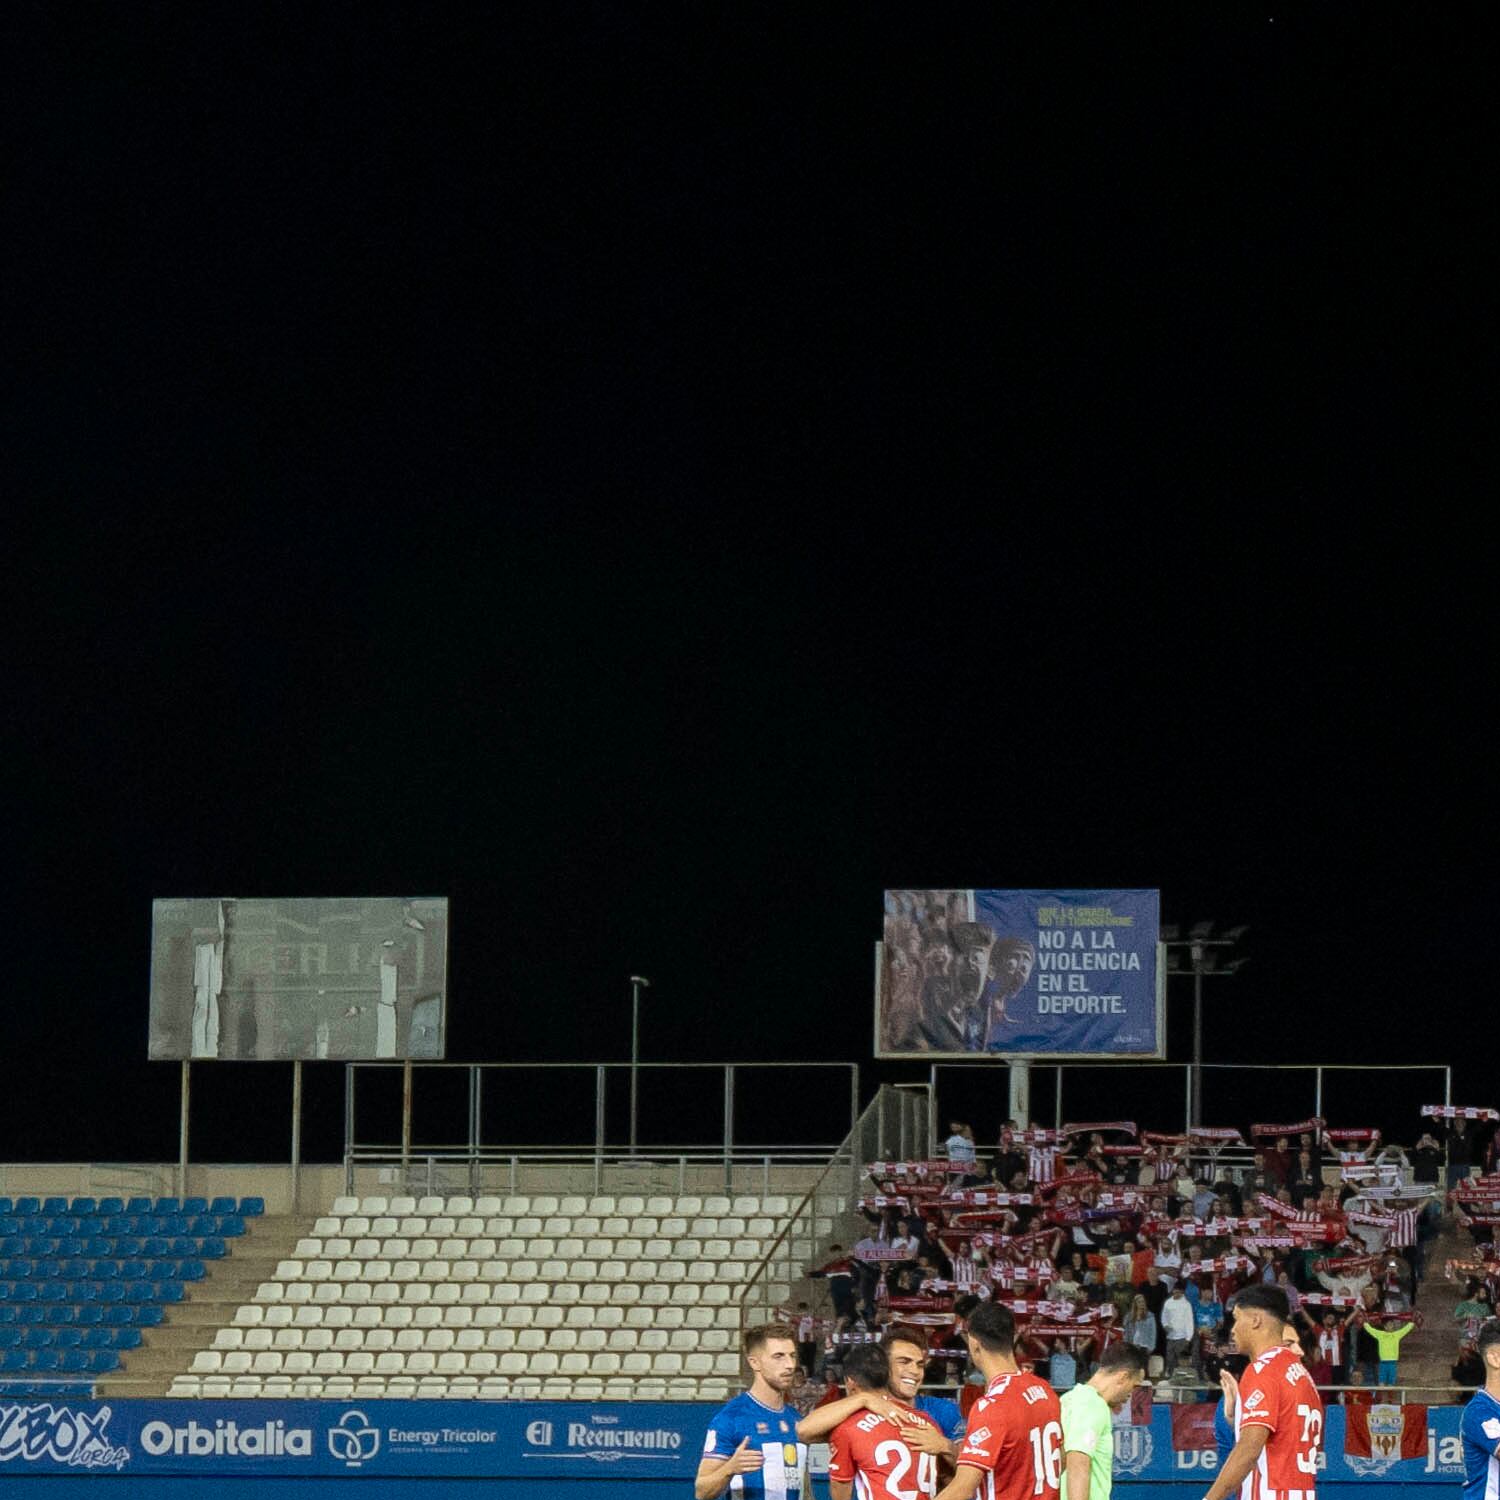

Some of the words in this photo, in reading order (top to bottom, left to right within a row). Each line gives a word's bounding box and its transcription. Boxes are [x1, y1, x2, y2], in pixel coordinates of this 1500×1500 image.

[1038, 930, 1066, 949] NO
[1071, 930, 1085, 949] A
[1091, 930, 1116, 949] LA
[1038, 952, 1141, 971] VIOLENCIA
[1037, 974, 1063, 993] EN
[1068, 974, 1090, 993] EL
[1037, 995, 1128, 1014] DEPORTE.
[140, 1419, 312, 1456] Orbitalia
[388, 1428, 439, 1446] Energy
[441, 1428, 498, 1443] Tricolor
[567, 1422, 681, 1449] Reencuentro
[1029, 1420, 1062, 1495] 16
